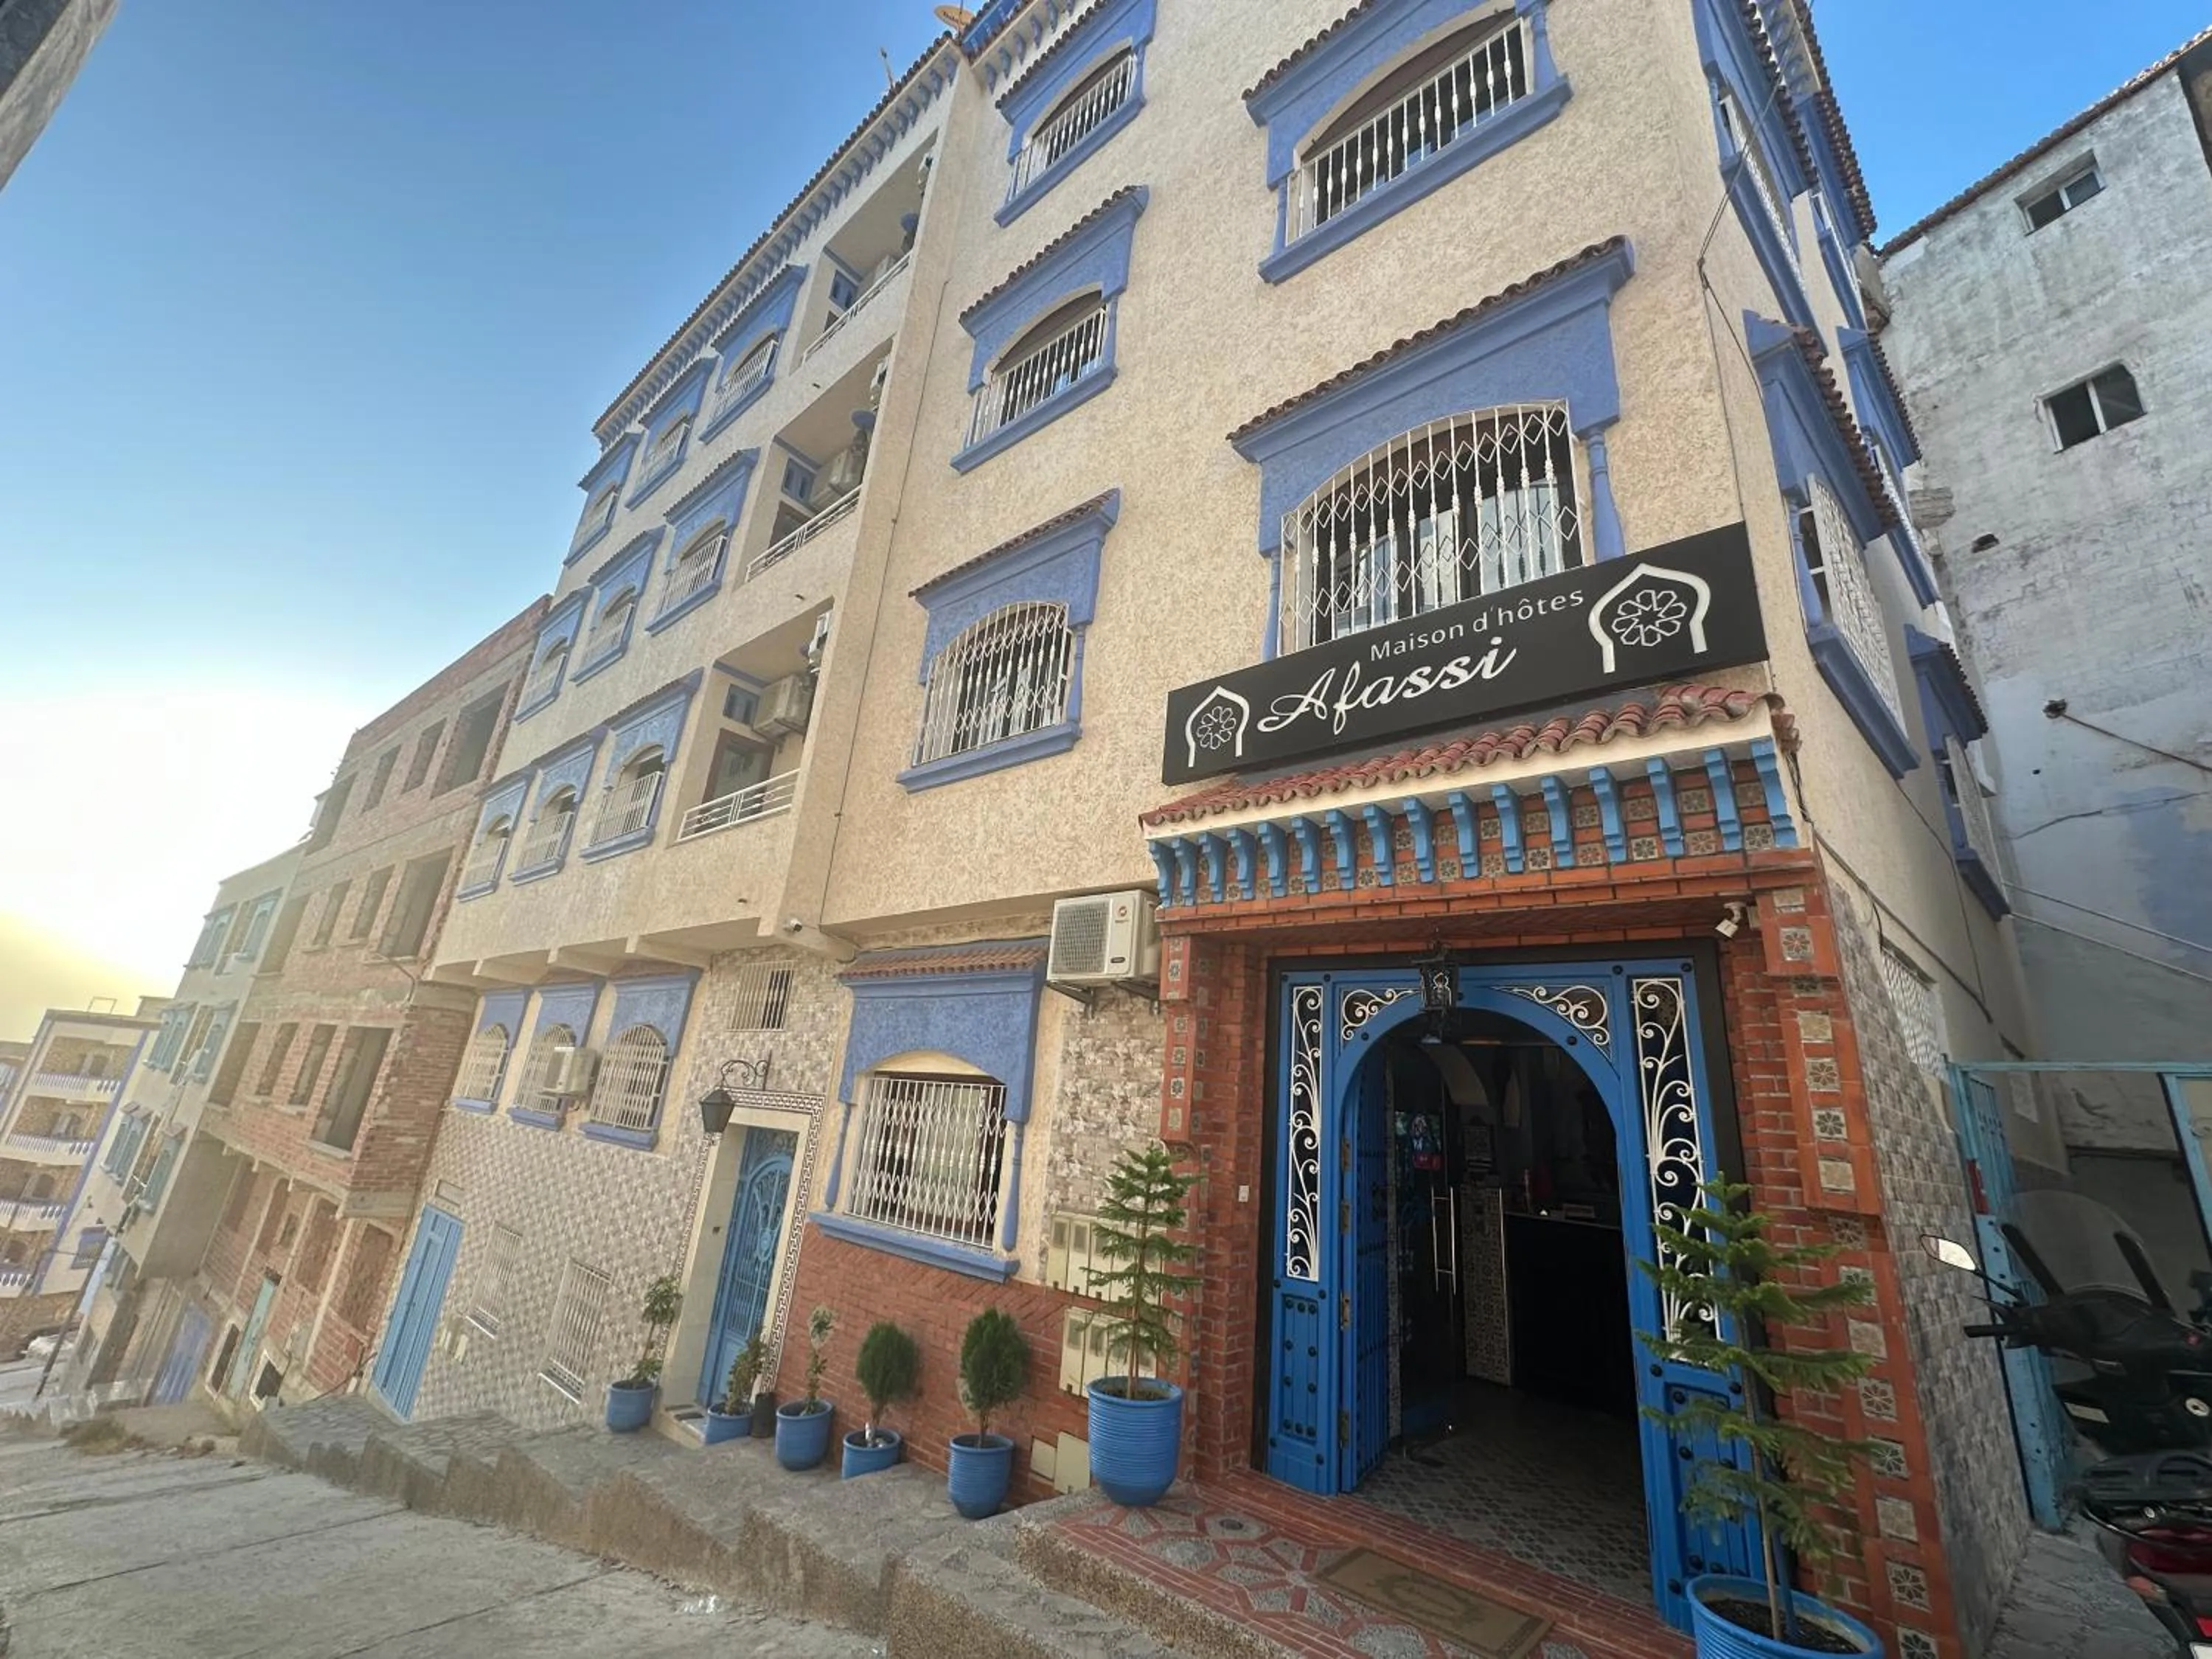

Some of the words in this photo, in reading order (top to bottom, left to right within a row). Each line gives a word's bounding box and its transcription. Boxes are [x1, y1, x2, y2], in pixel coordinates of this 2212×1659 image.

[1370, 624, 1464, 661] Maison
[1472, 590, 1585, 633] d'hôtes
[1256, 636, 1517, 735] Afassi
